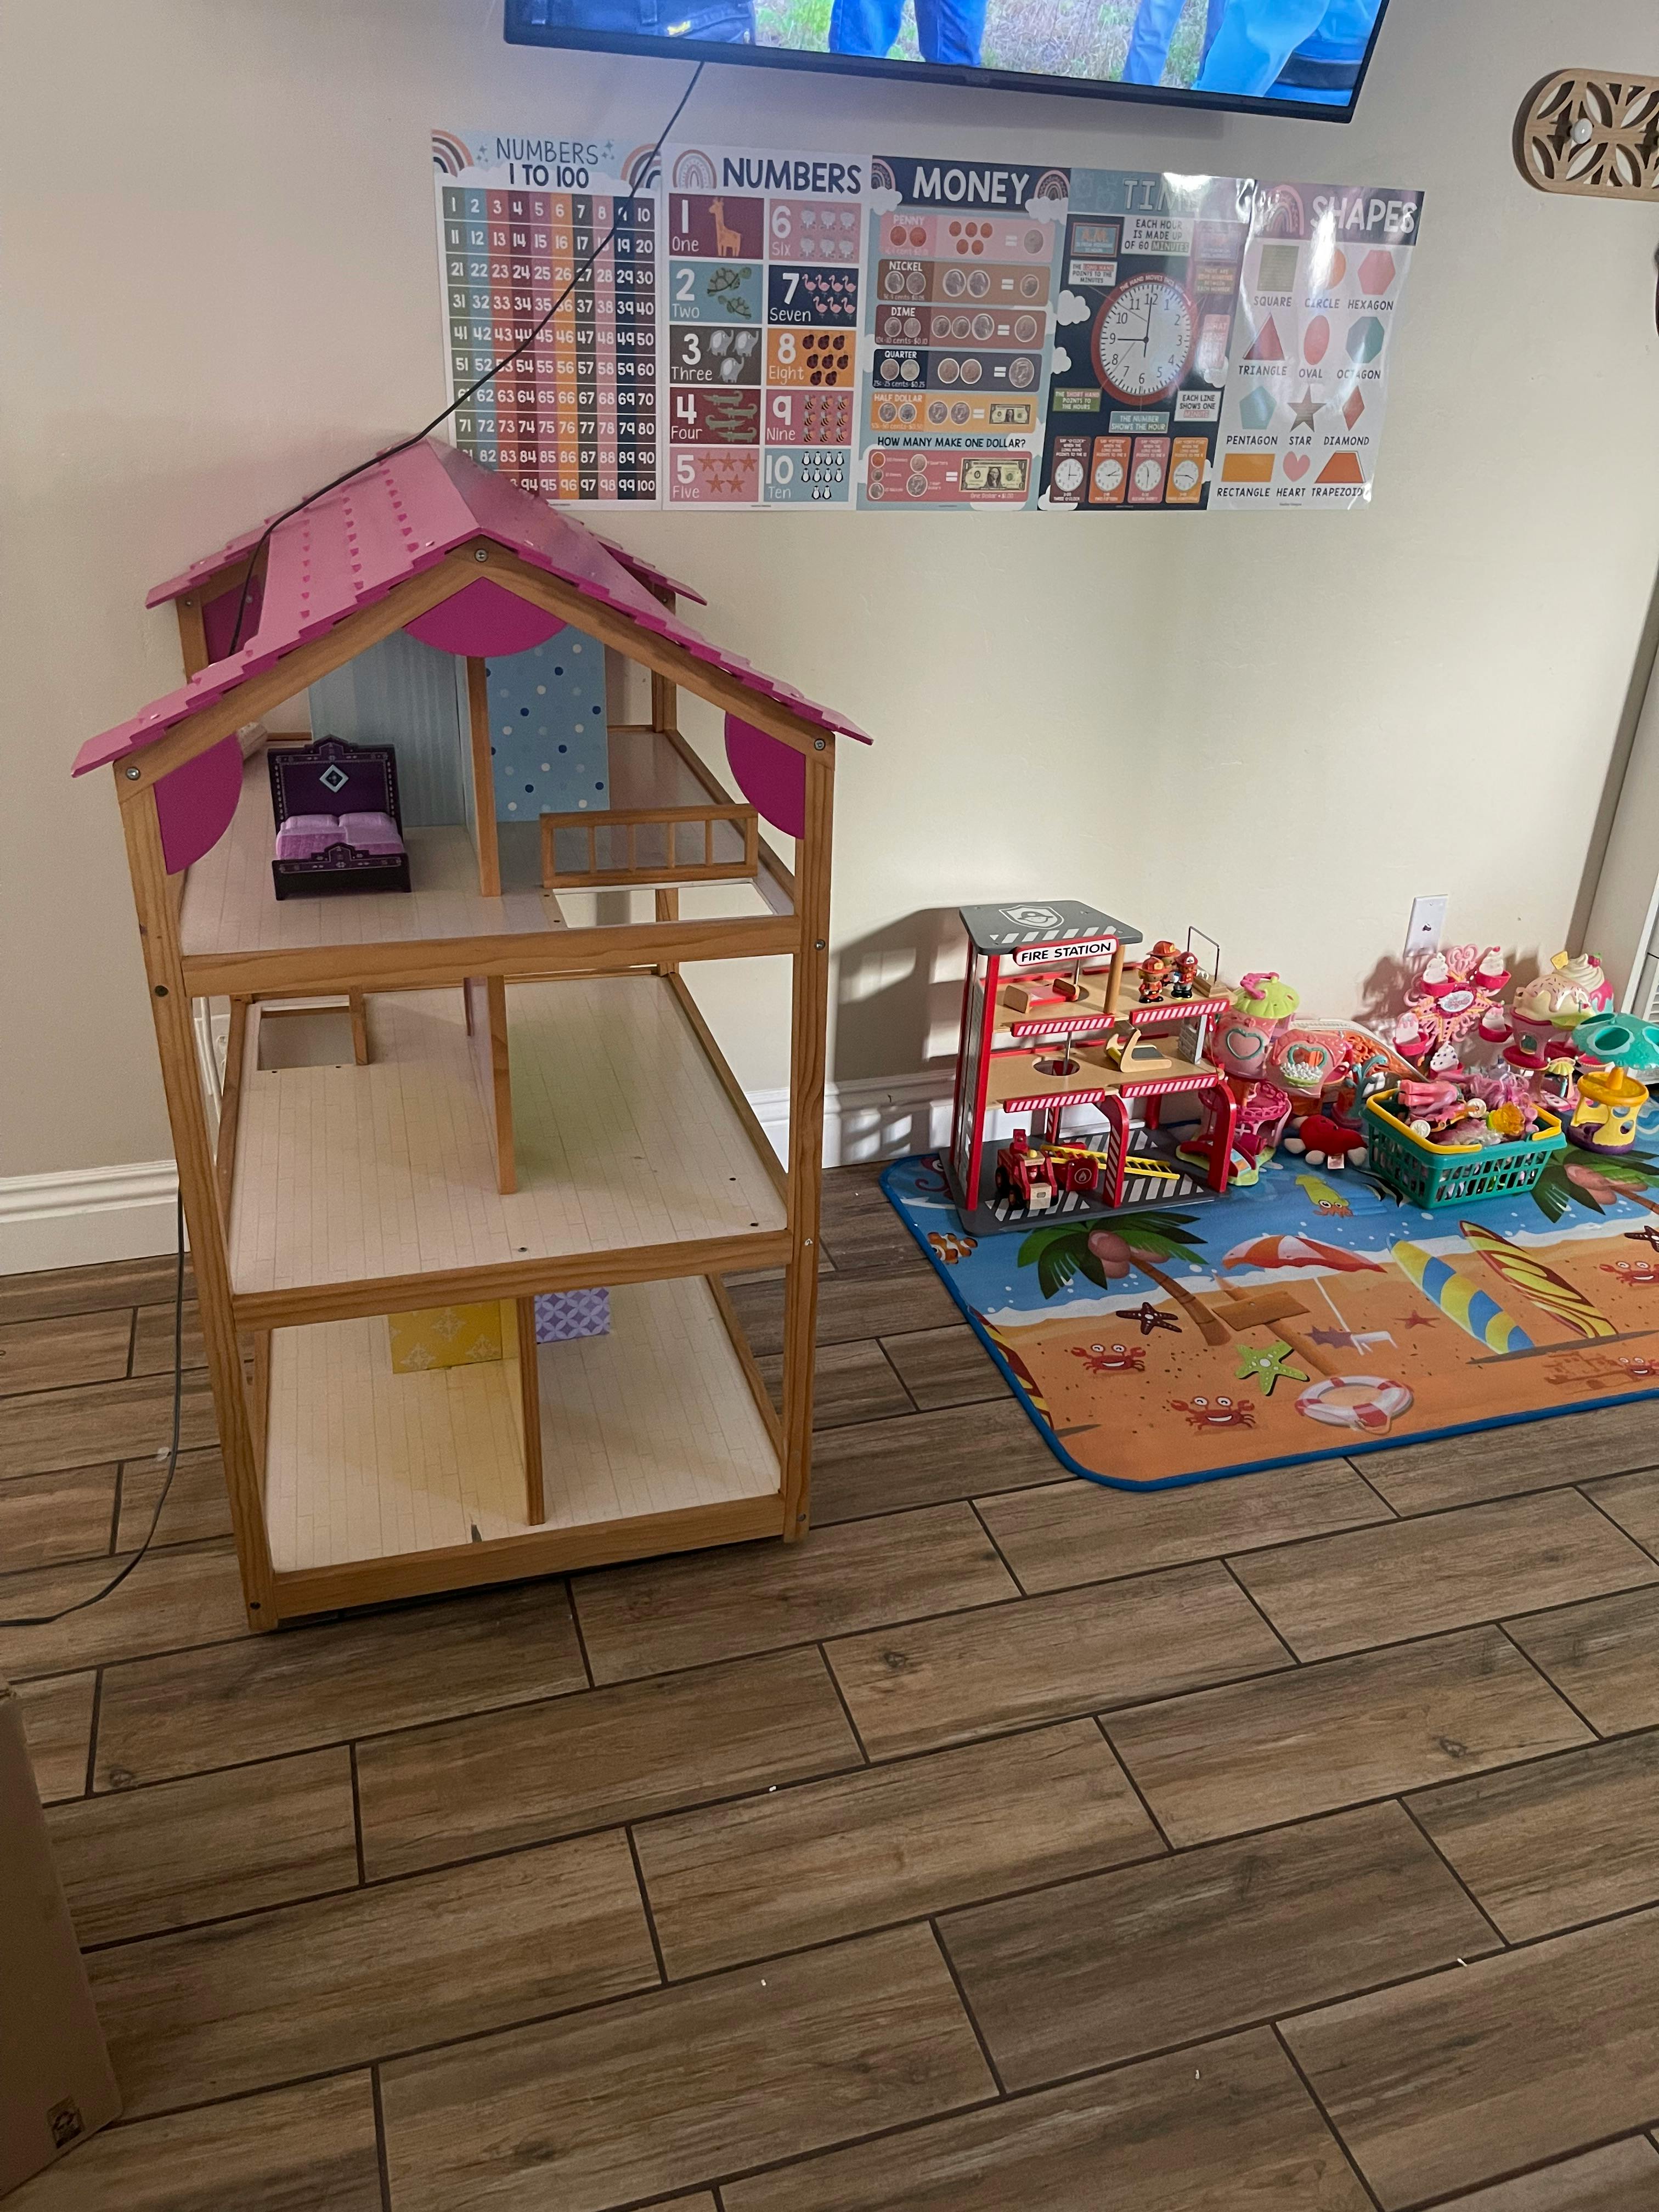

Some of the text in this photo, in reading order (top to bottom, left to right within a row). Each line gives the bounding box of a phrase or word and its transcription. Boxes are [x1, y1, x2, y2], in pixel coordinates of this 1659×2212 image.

[496, 138, 599, 164] NUMBERS
[510, 163, 589, 188] 1 TO 100
[723, 157, 861, 194] NUMBERS
[912, 166, 1030, 204] MONEY
[452, 197, 456, 212] 1
[471, 199, 479, 213] 2
[493, 200, 501, 213] 3
[513, 201, 522, 215] 4
[535, 202, 544, 216] 5
[556, 204, 564, 217] 6
[577, 205, 585, 218] 7
[598, 206, 606, 219] 8
[638, 208, 650, 222] 10
[1311, 196, 1418, 234] SHAPES
[682, 200, 689, 234] 1
[772, 206, 791, 238] 6
[893, 215, 925, 225] PENNY
[1136, 219, 1182, 229] EACH HOUR
[1133, 230, 1142, 239] IS
[1146, 231, 1170, 239] MADE
[672, 236, 699, 252] One
[1152, 241, 1188, 252] MINUTES
[889, 261, 922, 272] NICKEL
[451, 263, 653, 284] 21 22 23 24 25 26 27 28 29 30
[676, 268, 695, 301] 2
[783, 273, 799, 304] 7
[1130, 298, 1140, 310] 11
[1145, 294, 1158, 305] 12
[1164, 299, 1169, 310] 1
[1254, 296, 1394, 311] SQUARE CIRCLE HEXAGON
[672, 303, 699, 318] Two
[770, 308, 811, 322] Seven
[891, 307, 915, 316] DIME
[1116, 313, 1127, 324] 10
[1175, 314, 1180, 325] 2
[454, 326, 653, 346] 41 42 43 44 45 46 47 48 49 50
[1110, 333, 1115, 344] 9
[1176, 335, 1182, 346] 3
[682, 334, 701, 365] 3
[778, 333, 796, 364] 8
[1112, 354, 1118, 365] 8
[1168, 354, 1174, 365] 4
[672, 367, 712, 381] Three
[1123, 366, 1130, 377] 7
[1157, 366, 1162, 377] 5
[1239, 366, 1287, 375] TRIANGLE
[1299, 369, 1322, 378] OVAL
[1139, 373, 1145, 384] 6
[677, 394, 697, 424] 4
[773, 396, 791, 425] 9
[459, 419, 654, 435] 71 72 73 74 75 76 77 78 79 80
[672, 426, 702, 439] Four
[878, 436, 1025, 448] HOW MANY MAKE ONE DOLLAR?
[1226, 436, 1369, 445] PENTAGON STAR DIAMOND
[677, 455, 695, 484] 5
[766, 455, 793, 484] 10
[521, 479, 655, 492] 94 95 96 97 98 99 100
[1217, 488, 1363, 496] RECTANGLE HEART TRAPEZOID
[769, 487, 791, 499] Ten
[1022, 943, 1110, 962] FIRE STATION
